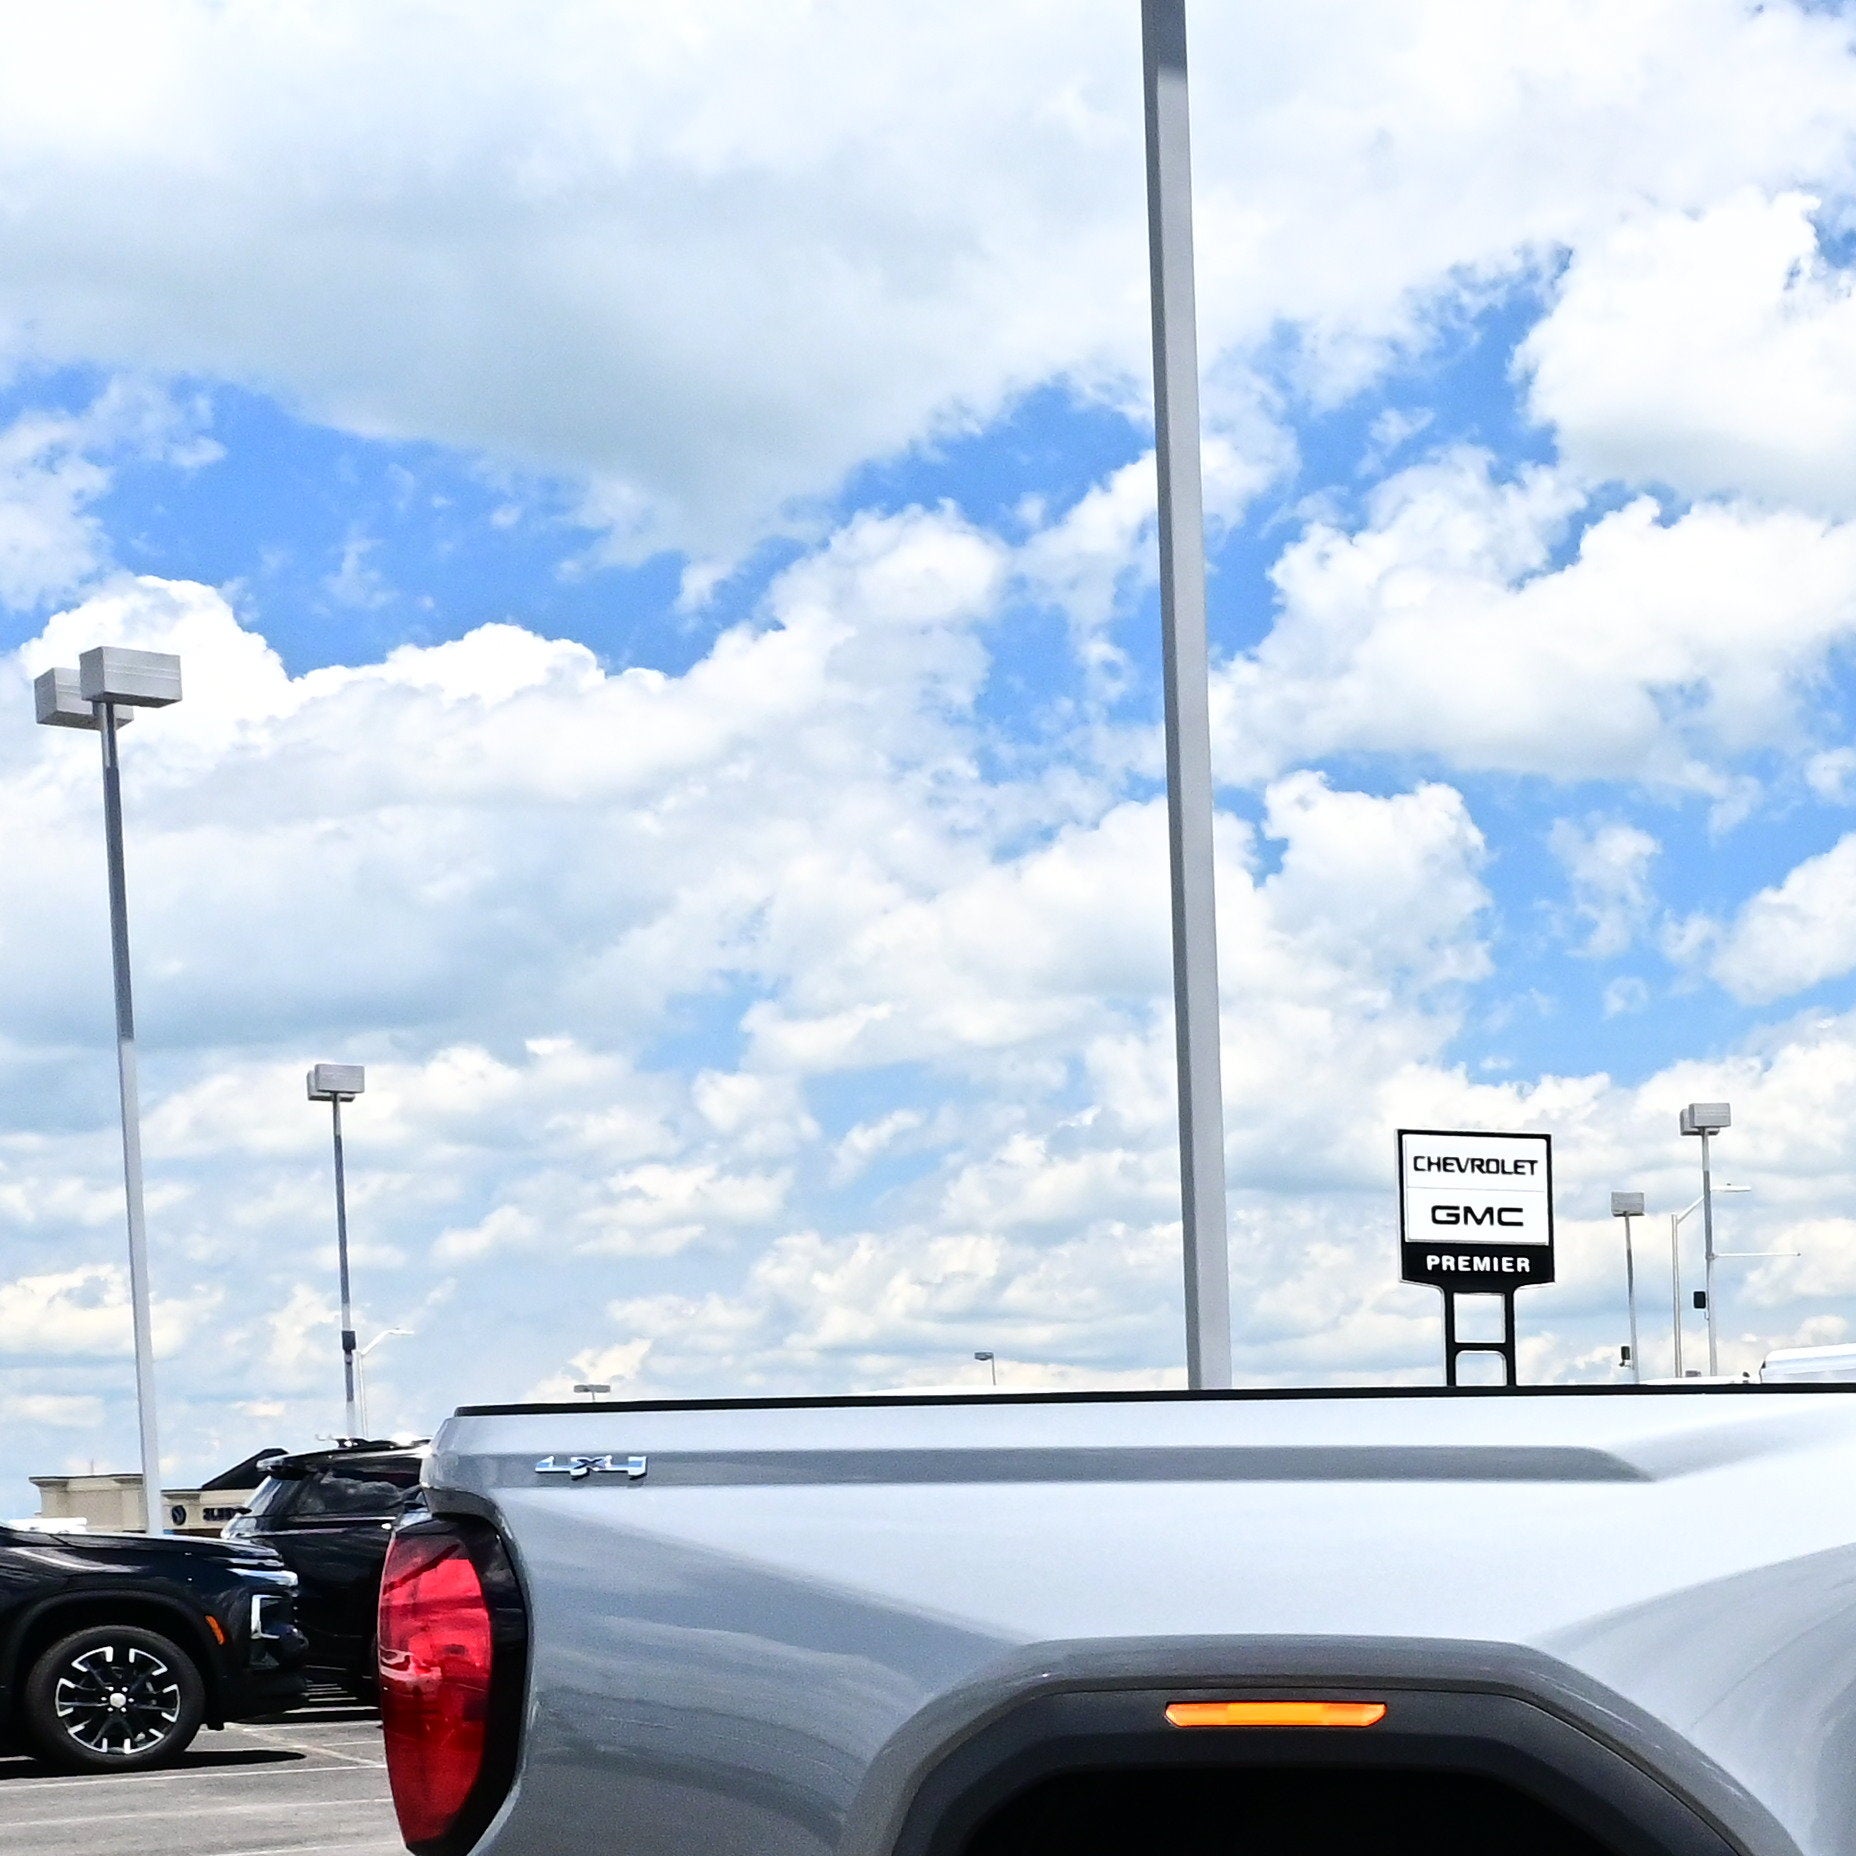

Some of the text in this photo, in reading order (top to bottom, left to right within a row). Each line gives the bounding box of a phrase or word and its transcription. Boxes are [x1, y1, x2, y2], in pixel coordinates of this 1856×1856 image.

[1413, 1156, 1538, 1175] CHEVROLET
[1431, 1205, 1524, 1227] GMC
[1426, 1254, 1531, 1273] PREMIER
